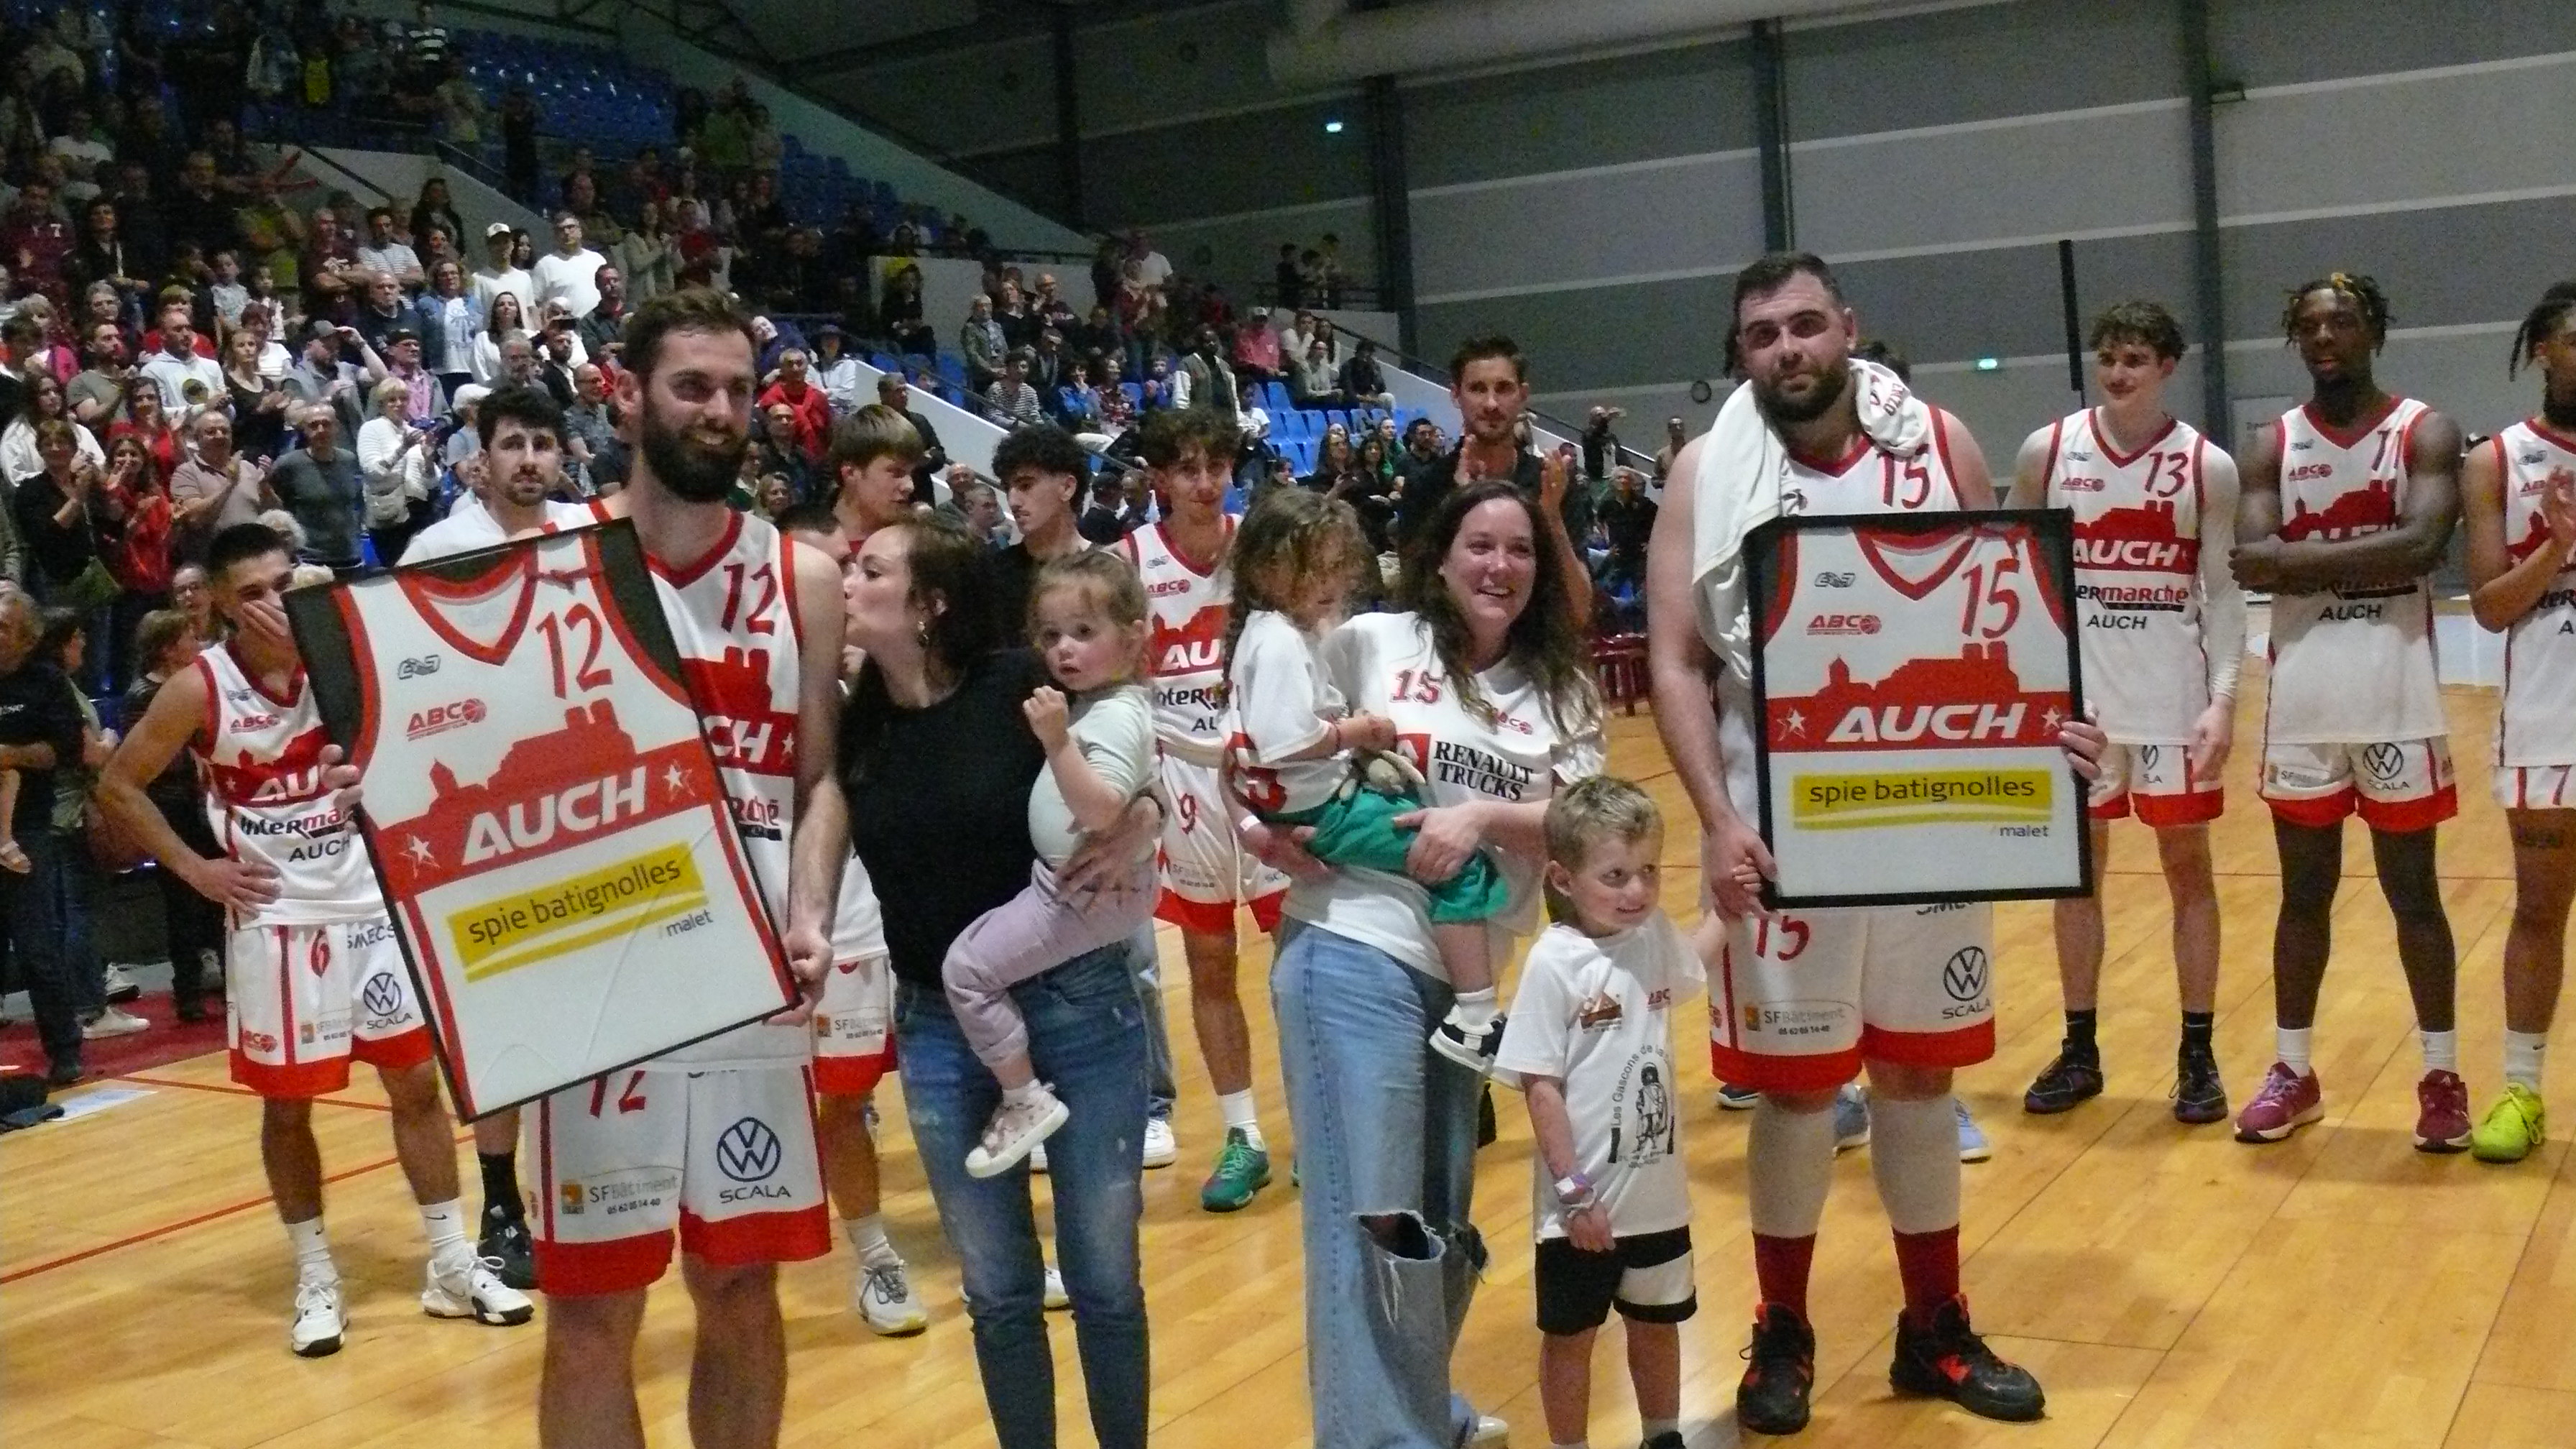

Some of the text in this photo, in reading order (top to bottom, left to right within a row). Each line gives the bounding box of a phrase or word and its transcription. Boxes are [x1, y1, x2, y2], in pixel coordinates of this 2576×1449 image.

[1876, 443, 1931, 509] 15
[2144, 452, 2188, 497] 13
[2074, 538, 2179, 566] AUCH
[724, 563, 777, 635] 12
[1961, 558, 2020, 638] 15
[2318, 604, 2382, 620] AUCH
[2087, 615, 2147, 629] AUCH
[536, 603, 612, 699] 12
[1389, 669, 1442, 705] 15
[1827, 703, 2027, 742] AUCH
[1435, 741, 1534, 784] RENAULT
[1438, 762, 1523, 801] TRUCKS
[1810, 776, 2036, 807] spie batignolles
[461, 766, 647, 865] AUCH
[2000, 824, 2049, 838] malet
[289, 834, 351, 862] AUCH
[468, 858, 681, 947] spie batignolles
[666, 908, 714, 937] malet
[311, 929, 331, 978] 6
[367, 1013, 413, 1029] SCALA
[1942, 998, 1991, 1019] SCALA
[1612, 1054, 1639, 1103] Gascons
[1611, 1106, 1622, 1127] Les
[720, 1185, 791, 1204] SCALA
